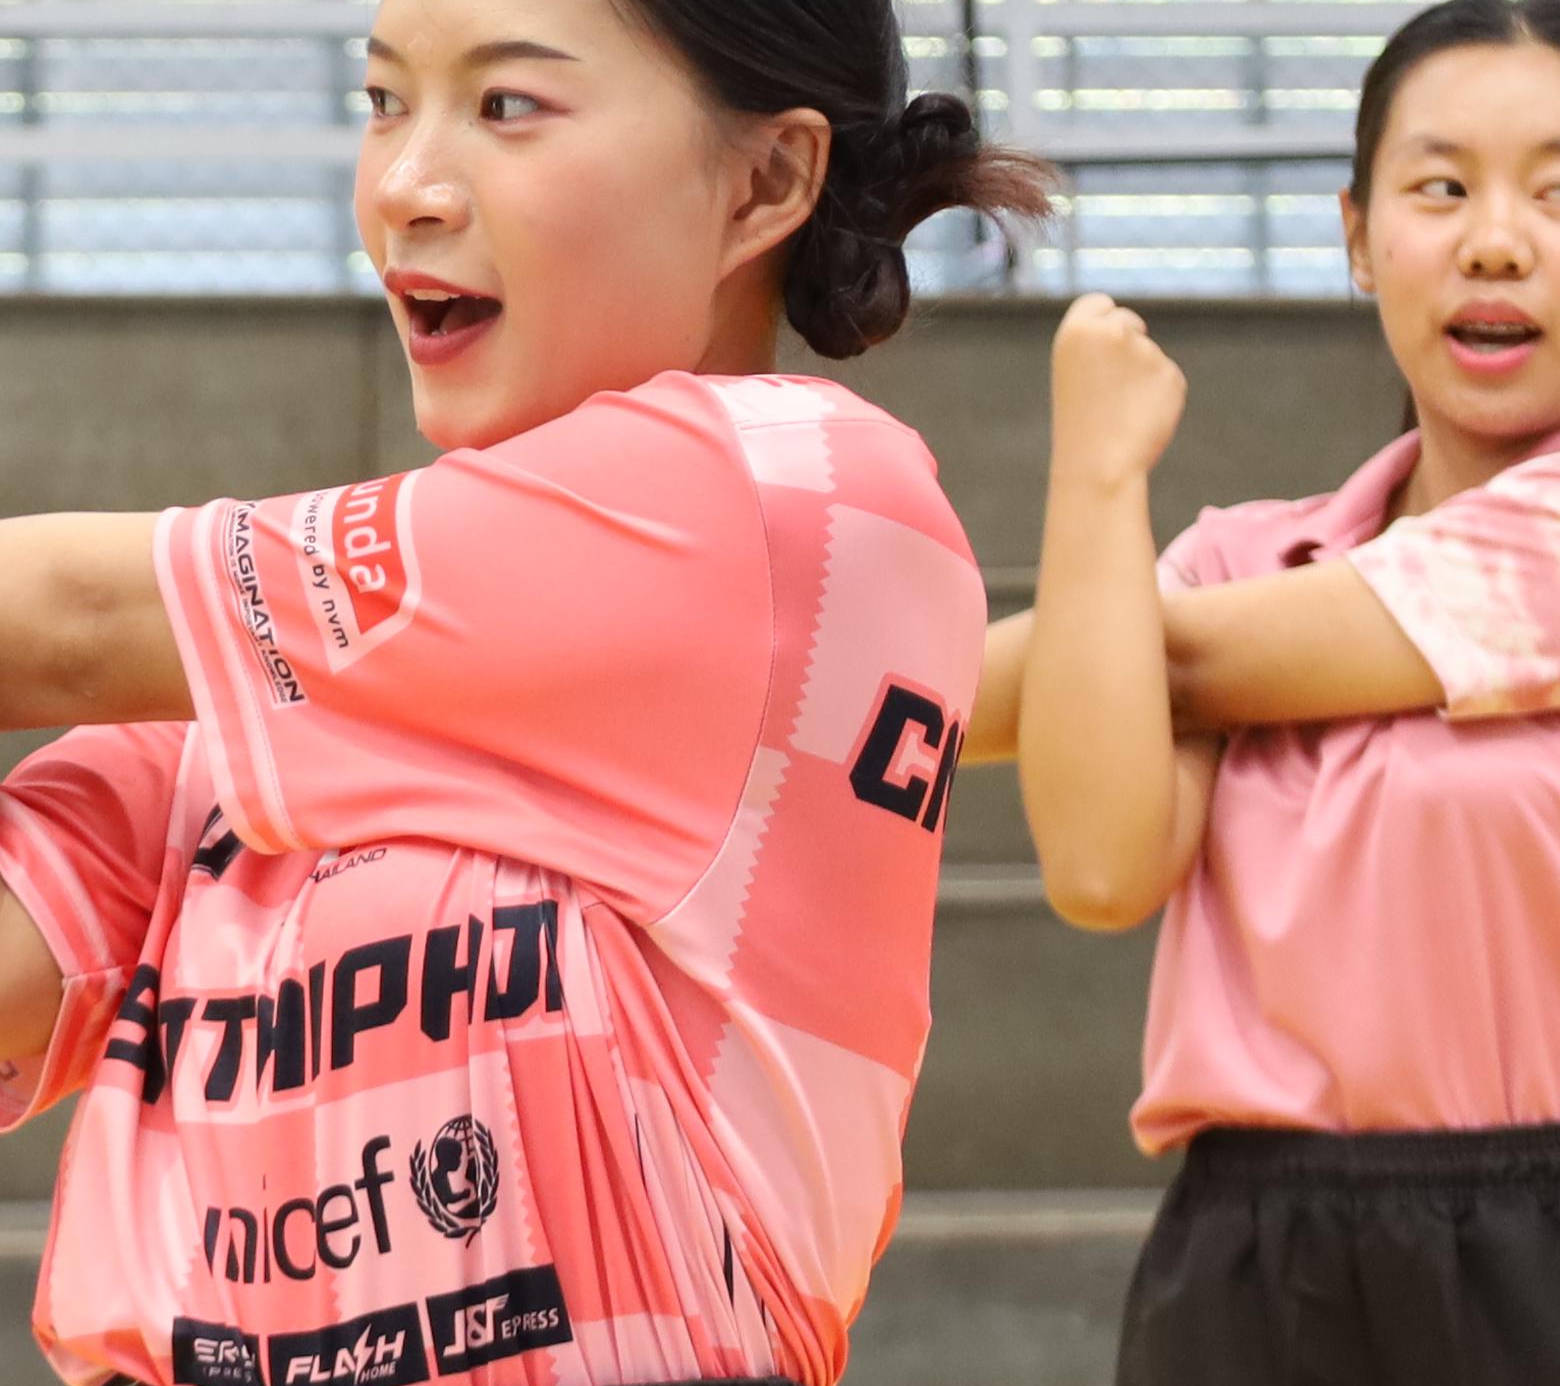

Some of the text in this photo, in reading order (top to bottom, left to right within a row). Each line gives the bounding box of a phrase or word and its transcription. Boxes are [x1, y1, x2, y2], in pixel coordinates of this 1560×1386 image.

[343, 477, 392, 594] unda
[235, 507, 306, 704] IMAGINATION
[312, 563, 330, 590] by
[322, 599, 350, 649] nvm
[360, 1360, 398, 1383] HOME
